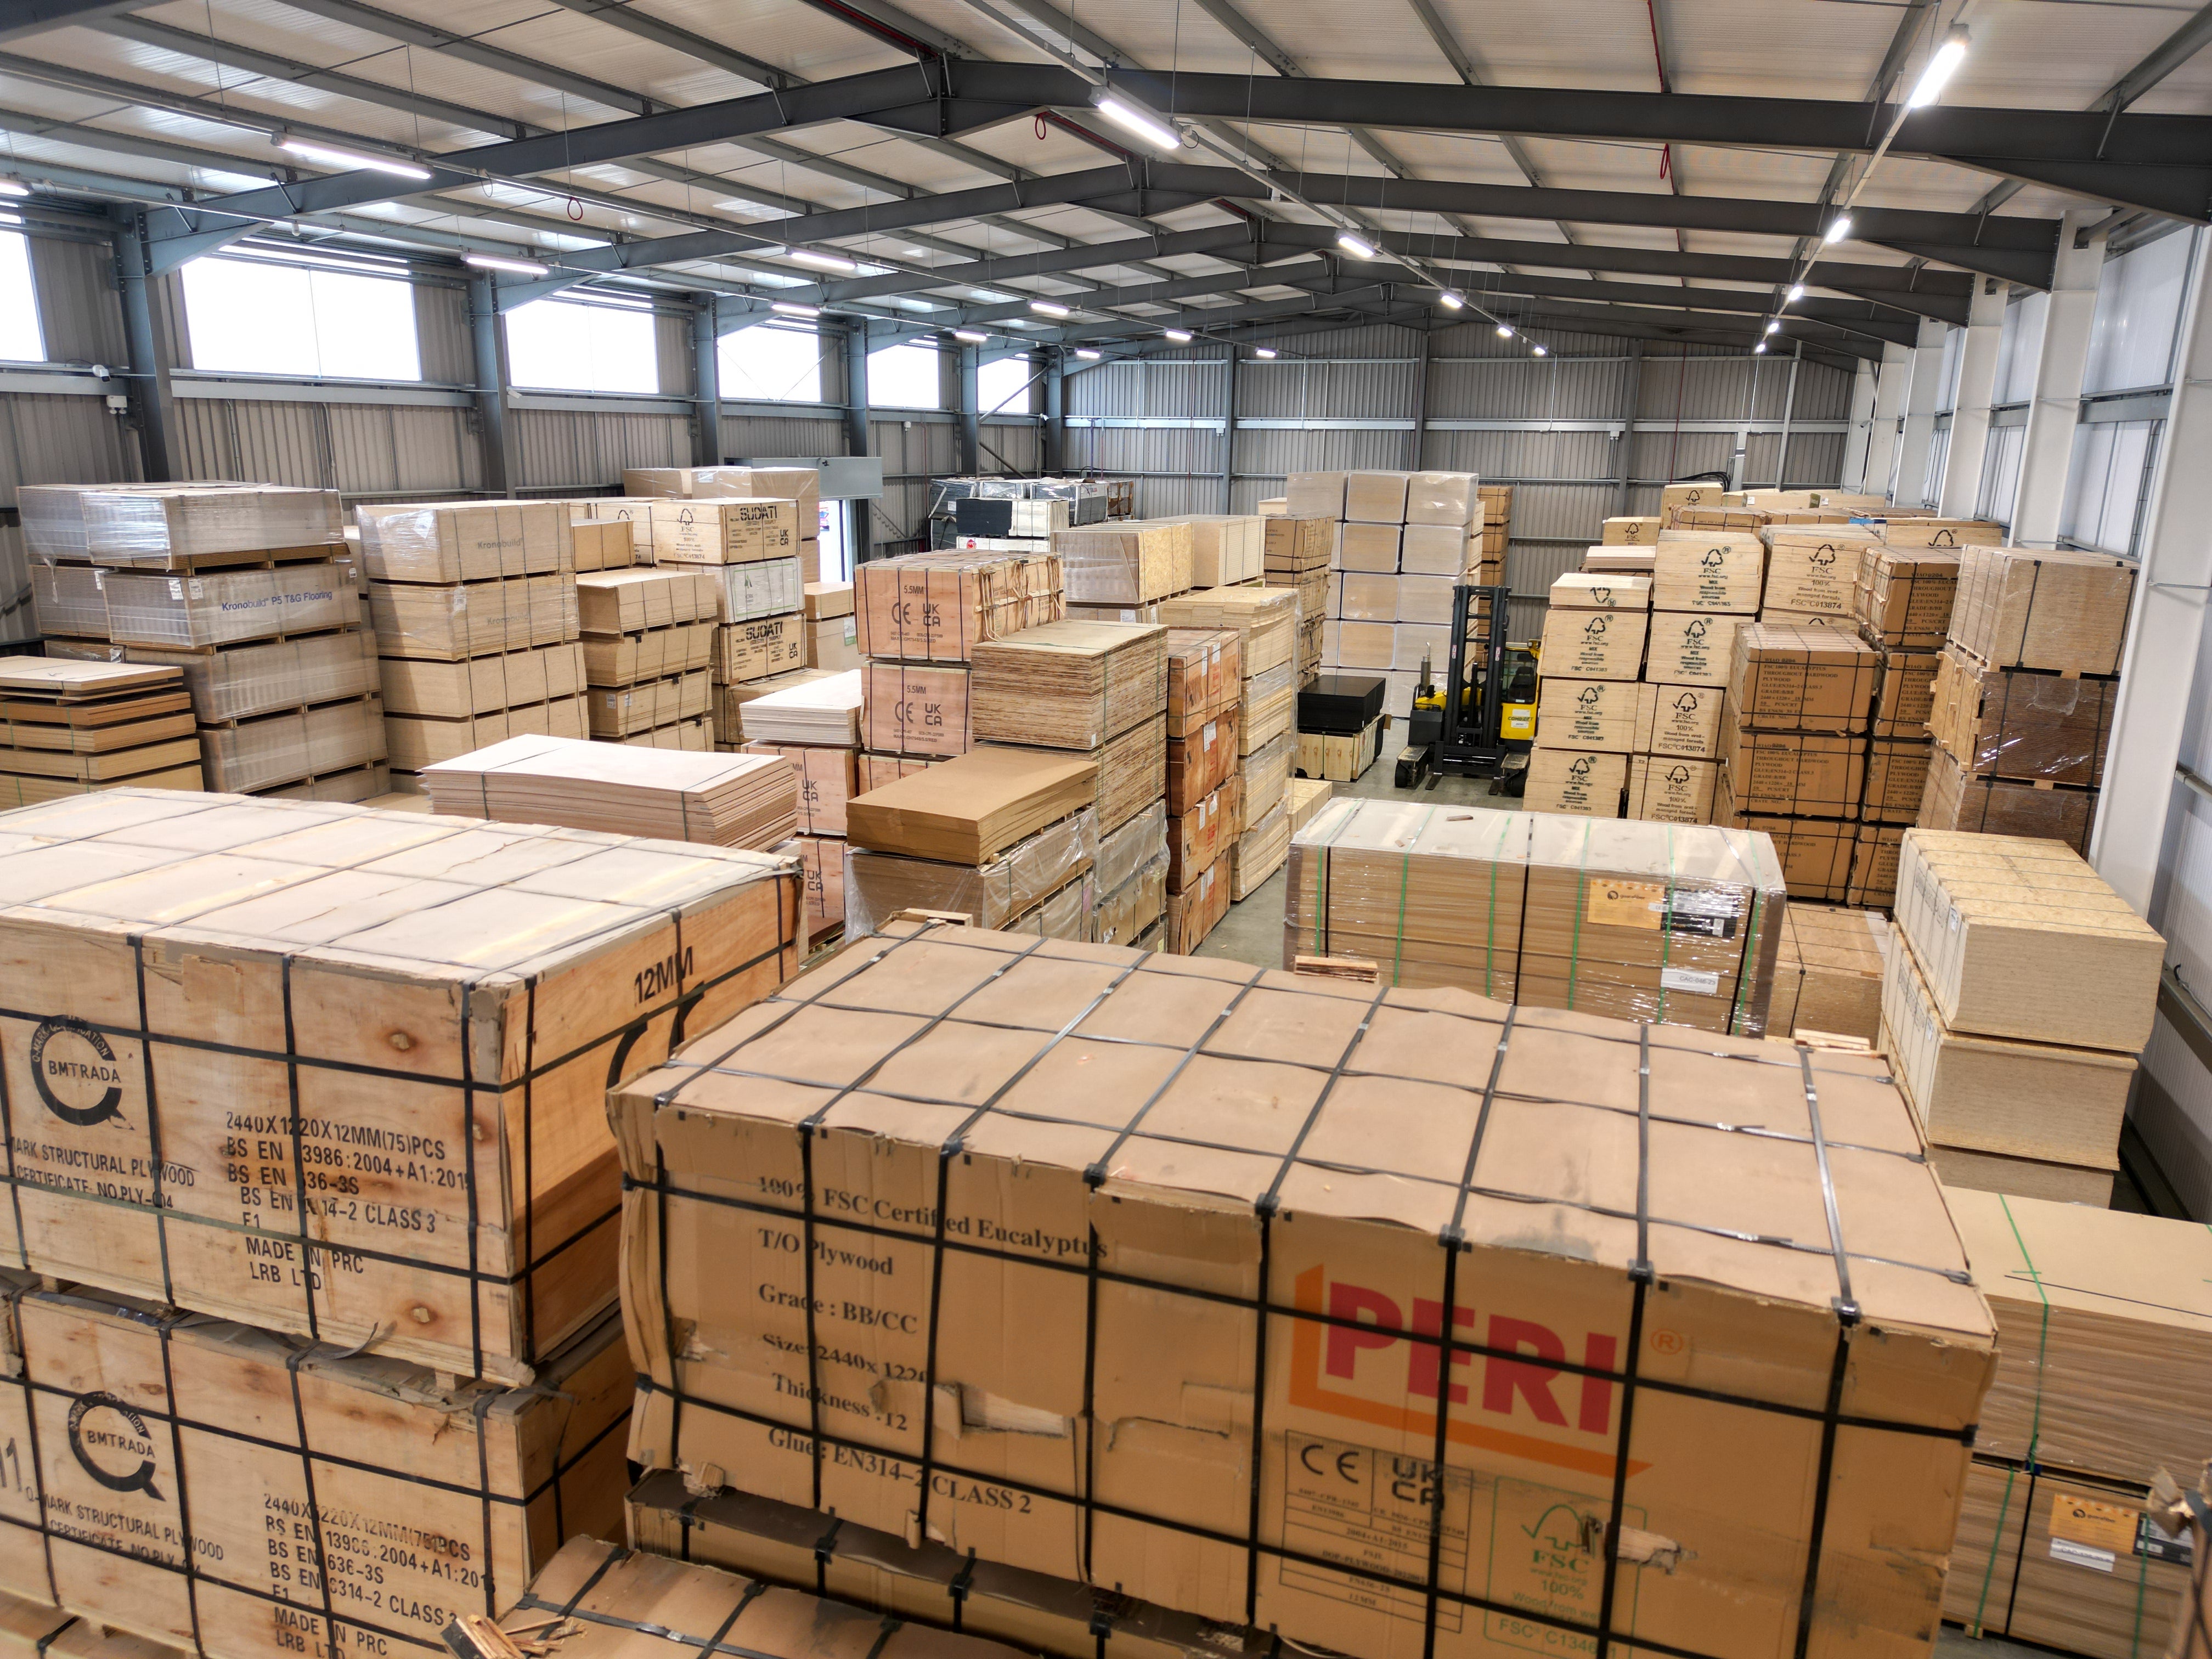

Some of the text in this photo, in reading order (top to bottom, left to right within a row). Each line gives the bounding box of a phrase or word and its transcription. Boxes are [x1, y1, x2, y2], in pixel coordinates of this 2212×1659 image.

[1812, 566, 1833, 574] FSC
[272, 591, 332, 605] P5 T&G Flooring
[904, 585, 923, 594] 5.5MM
[891, 602, 911, 625] CE
[923, 603, 939, 614] UK
[923, 616, 940, 627] CA
[906, 685, 926, 695] 5.5MM
[895, 701, 913, 724] CE
[925, 703, 941, 714] UK
[925, 715, 942, 726] CA
[802, 780, 817, 791] UK
[803, 791, 818, 802] CA
[808, 870, 821, 880] UK
[808, 881, 823, 891] CA
[49, 1060, 121, 1083] BMTRADA
[42, 1143, 127, 1175] STRUCTURAL
[227, 1136, 469, 1190] BS EN 3986:2004+A1:201
[228, 1163, 360, 1195] BS EN 36-3S
[240, 1186, 436, 1233] BS EN CLASS 3
[823, 1188, 870, 1216] FSC
[873, 1200, 970, 1235] Certifed
[758, 1229, 800, 1252] T/O
[246, 1237, 364, 1274] MADE N PRC
[250, 1261, 281, 1284] LRB
[843, 1300, 918, 1335] BB/CC
[1326, 1281, 1617, 1436] PERI
[885, 1412, 909, 1431] 12
[87, 1430, 156, 1459] BMTRADA
[769, 1428, 815, 1457] Glue
[933, 1474, 1013, 1510] CLASS
[1019, 1496, 1032, 1514] 2
[1301, 1443, 1359, 1485] CE
[77, 1504, 160, 1540] STRUCTURAL
[295, 1523, 315, 1543] EN
[268, 1538, 289, 1559] BS
[297, 1546, 317, 1565] EN
[1533, 1550, 1589, 1575] FSC
[270, 1561, 291, 1581] BS
[300, 1569, 320, 1589] EN
[390, 1595, 444, 1627] CLASS
[1542, 1579, 1584, 1600] 100%
[274, 1606, 387, 1656] MADE N PRC
[275, 1629, 346, 1659] LRB LD
